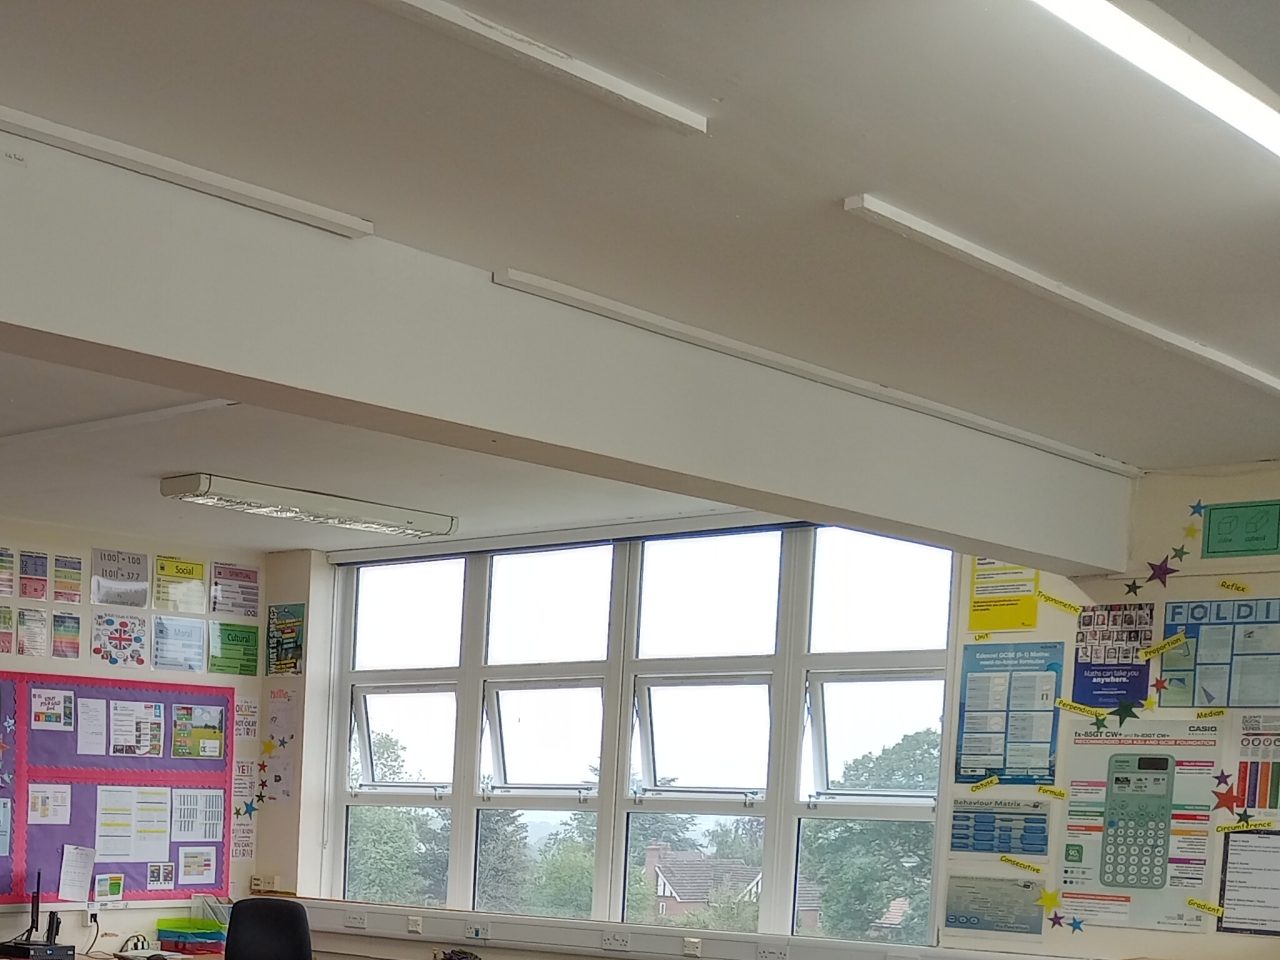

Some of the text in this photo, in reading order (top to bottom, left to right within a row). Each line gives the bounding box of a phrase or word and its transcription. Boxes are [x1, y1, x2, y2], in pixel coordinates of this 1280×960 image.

[175, 565, 194, 576] Social
[227, 633, 251, 643] Cultural
[1144, 637, 1182, 658] Proportion
[1058, 699, 1105, 719] Perpendicular
[1197, 710, 1225, 719] Median
[970, 779, 994, 792] Obtuse
[1038, 786, 1065, 798] Formula
[953, 799, 1021, 808] Behaviour Matrix
[1216, 821, 1273, 832] Circumference
[1000, 855, 1041, 873] Consecutive
[1187, 898, 1220, 915] Gradient
